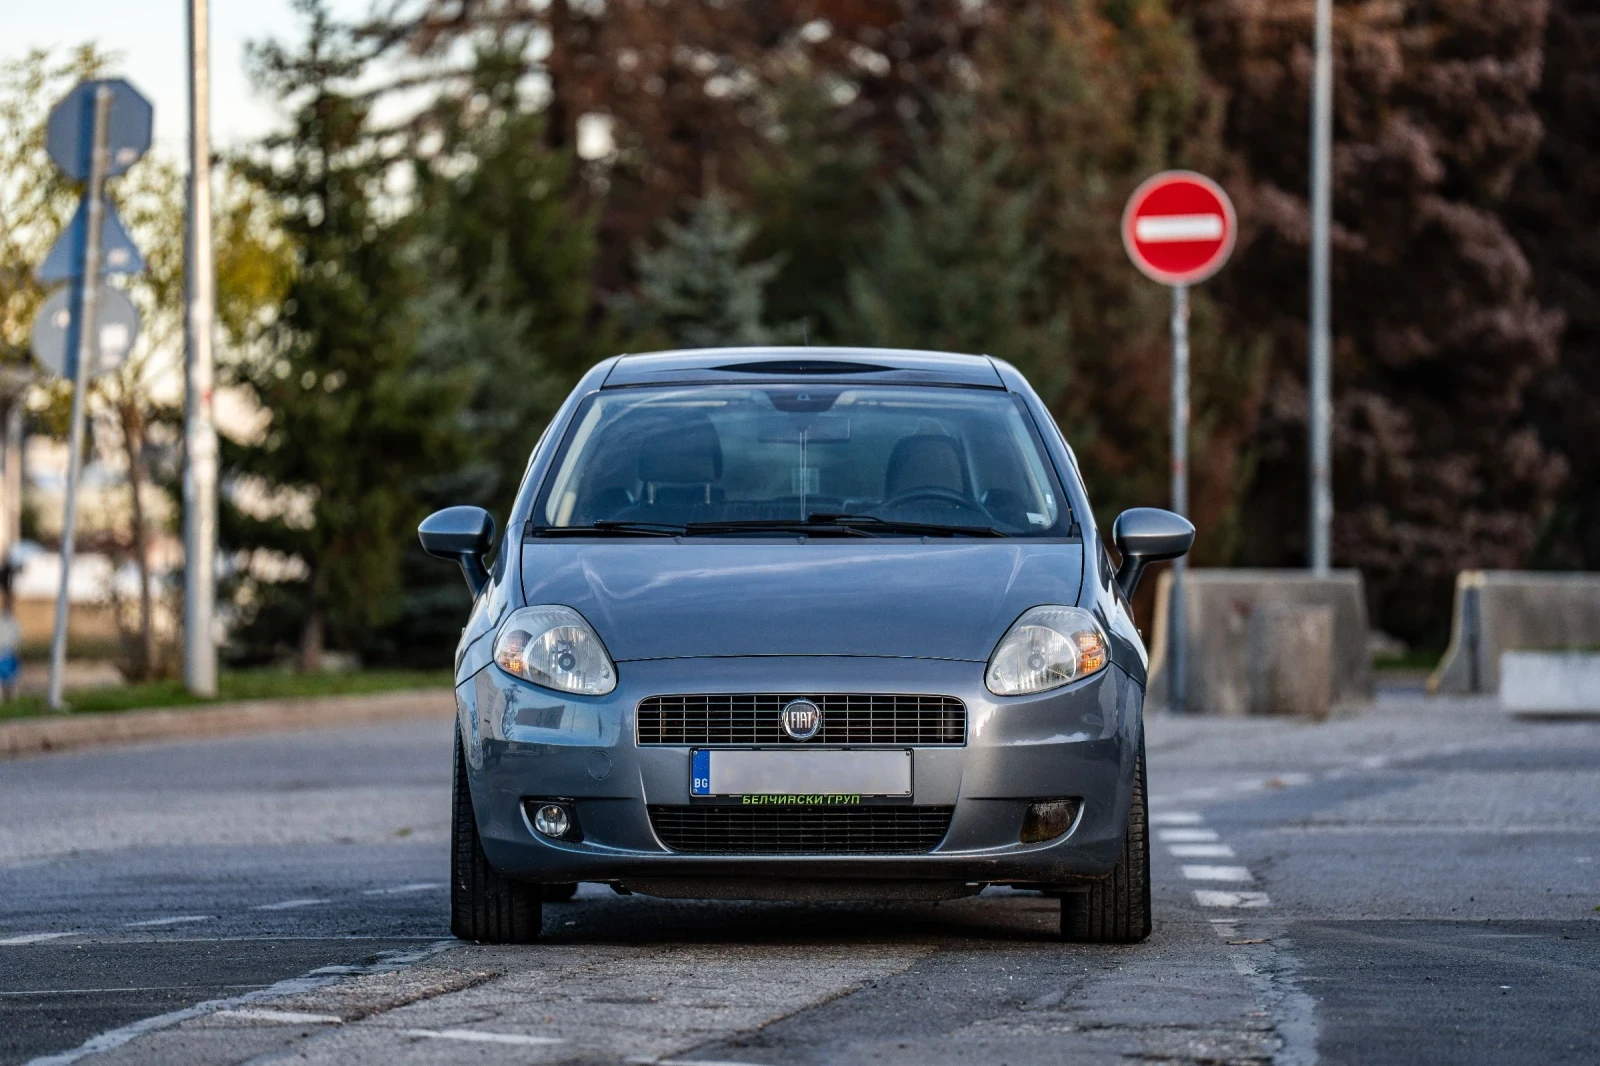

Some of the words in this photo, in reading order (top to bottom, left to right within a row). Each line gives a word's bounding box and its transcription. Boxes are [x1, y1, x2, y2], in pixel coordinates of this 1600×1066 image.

[791, 711, 812, 728] FIAT
[694, 778, 708, 788] BG
[742, 795, 824, 804] БЕЛЧИНСКИ
[827, 795, 860, 804] ГРУП
